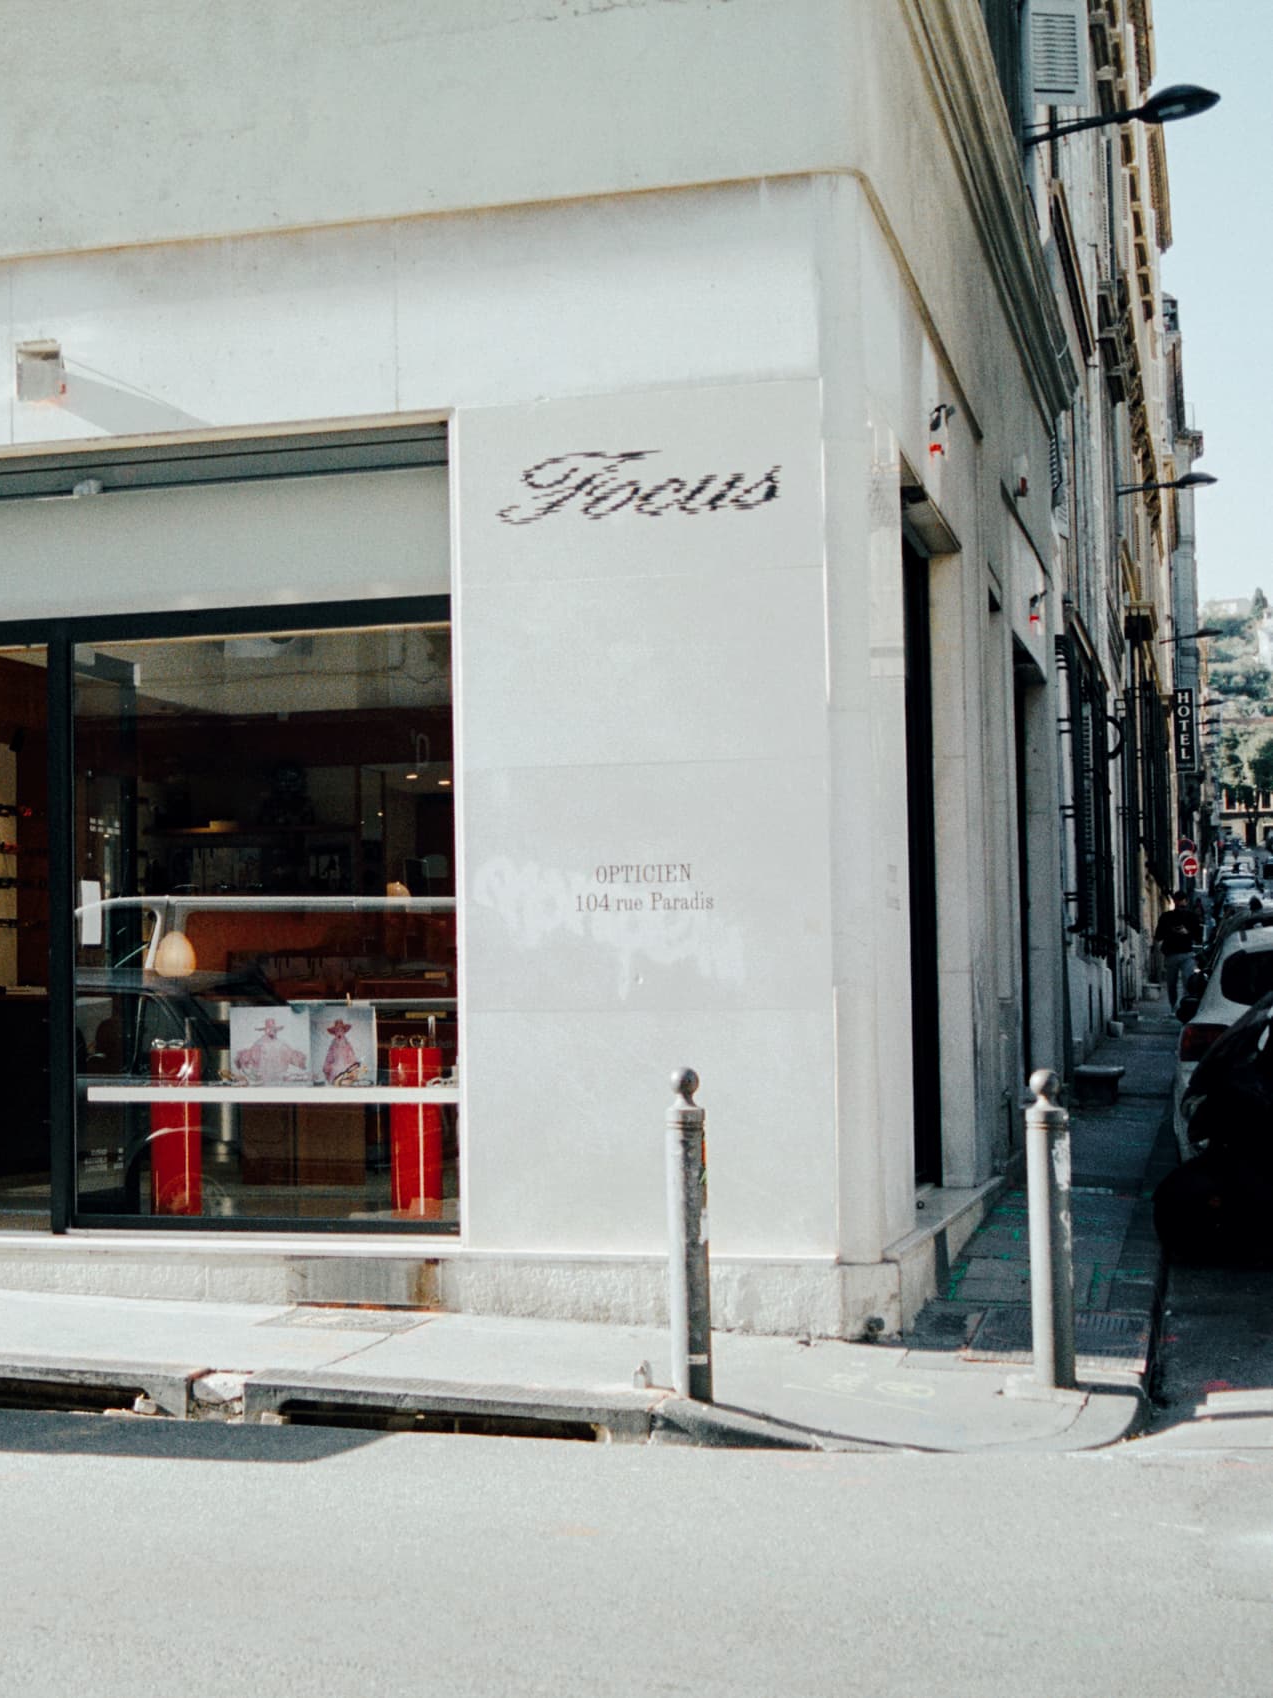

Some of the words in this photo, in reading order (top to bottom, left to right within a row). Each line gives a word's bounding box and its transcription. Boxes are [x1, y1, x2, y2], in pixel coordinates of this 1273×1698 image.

[497, 450, 781, 524] Focus
[1177, 692, 1190, 759] HOTEL
[595, 863, 692, 884] OPTICIEN
[576, 893, 611, 912] 104
[616, 897, 643, 911] rue
[650, 891, 714, 911] Paradis
